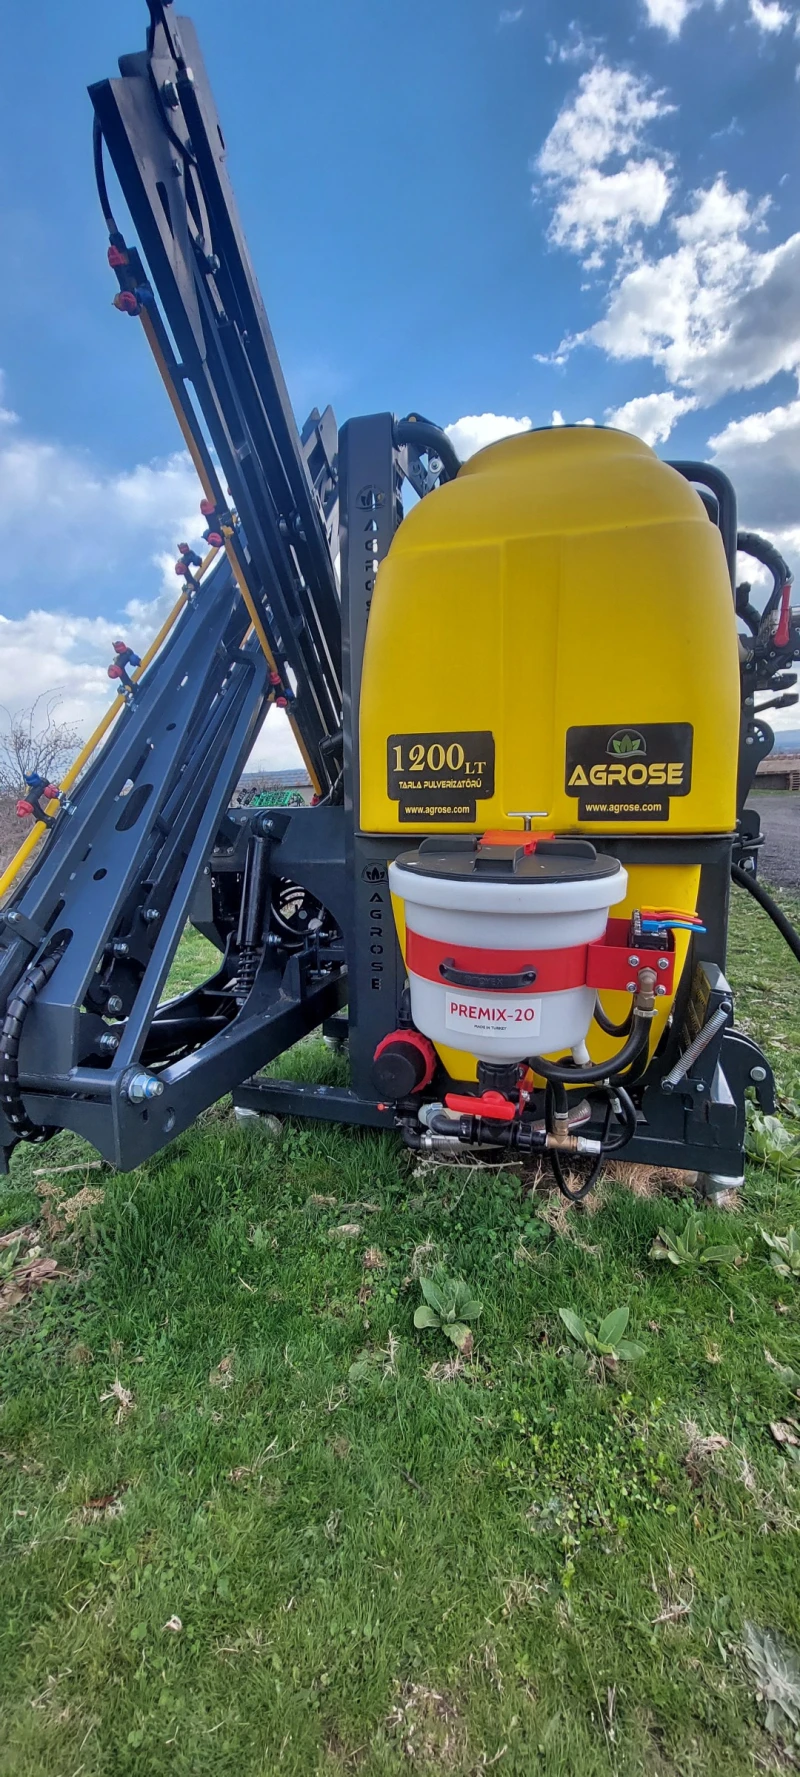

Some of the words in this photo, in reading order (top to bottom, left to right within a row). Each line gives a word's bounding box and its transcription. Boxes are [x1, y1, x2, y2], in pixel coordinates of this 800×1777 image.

[567, 762, 685, 787] AGROSE
[398, 780, 422, 789] TARLA
[404, 805, 470, 816] www.agrose.com
[585, 803, 662, 814] www.agrose.com
[369, 892, 384, 990] AGROSE
[450, 1002, 535, 1022] PREMIX-20
